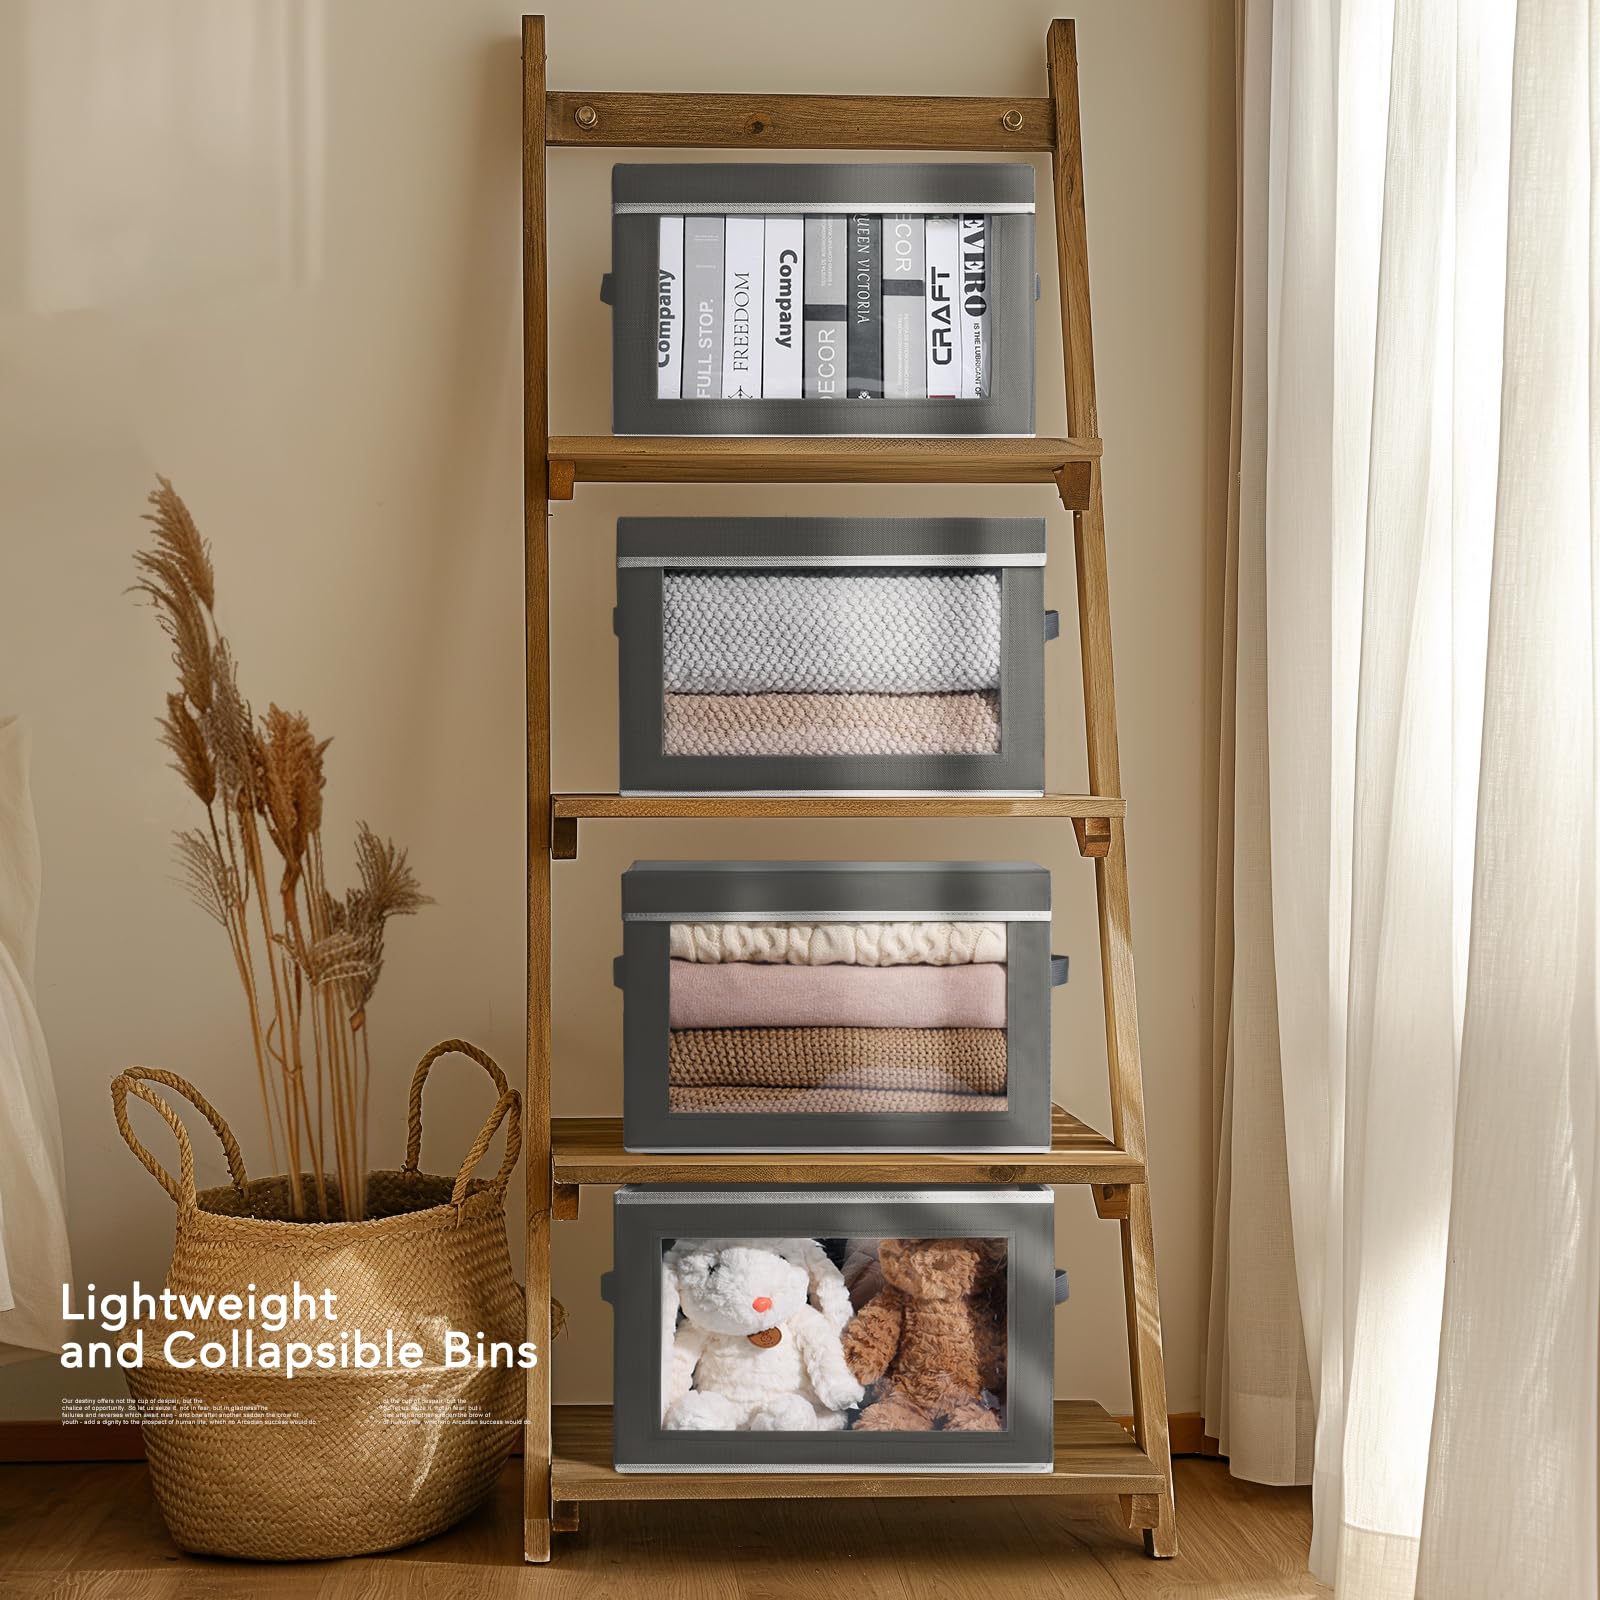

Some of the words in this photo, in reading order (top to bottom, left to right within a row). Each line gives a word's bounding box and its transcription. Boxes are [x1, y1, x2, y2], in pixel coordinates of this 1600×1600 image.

[658, 269, 676, 368] Company
[698, 298, 714, 348] STOP.
[733, 271, 750, 372] FREEDOM
[775, 249, 798, 348] Company
[856, 259, 871, 324] VICTORIA
[931, 266, 952, 365] CRAFT
[817, 329, 835, 399] ECOR
[973, 331, 981, 345] THE
[974, 346, 982, 385] LUBRICANT
[696, 354, 712, 399] FULL
